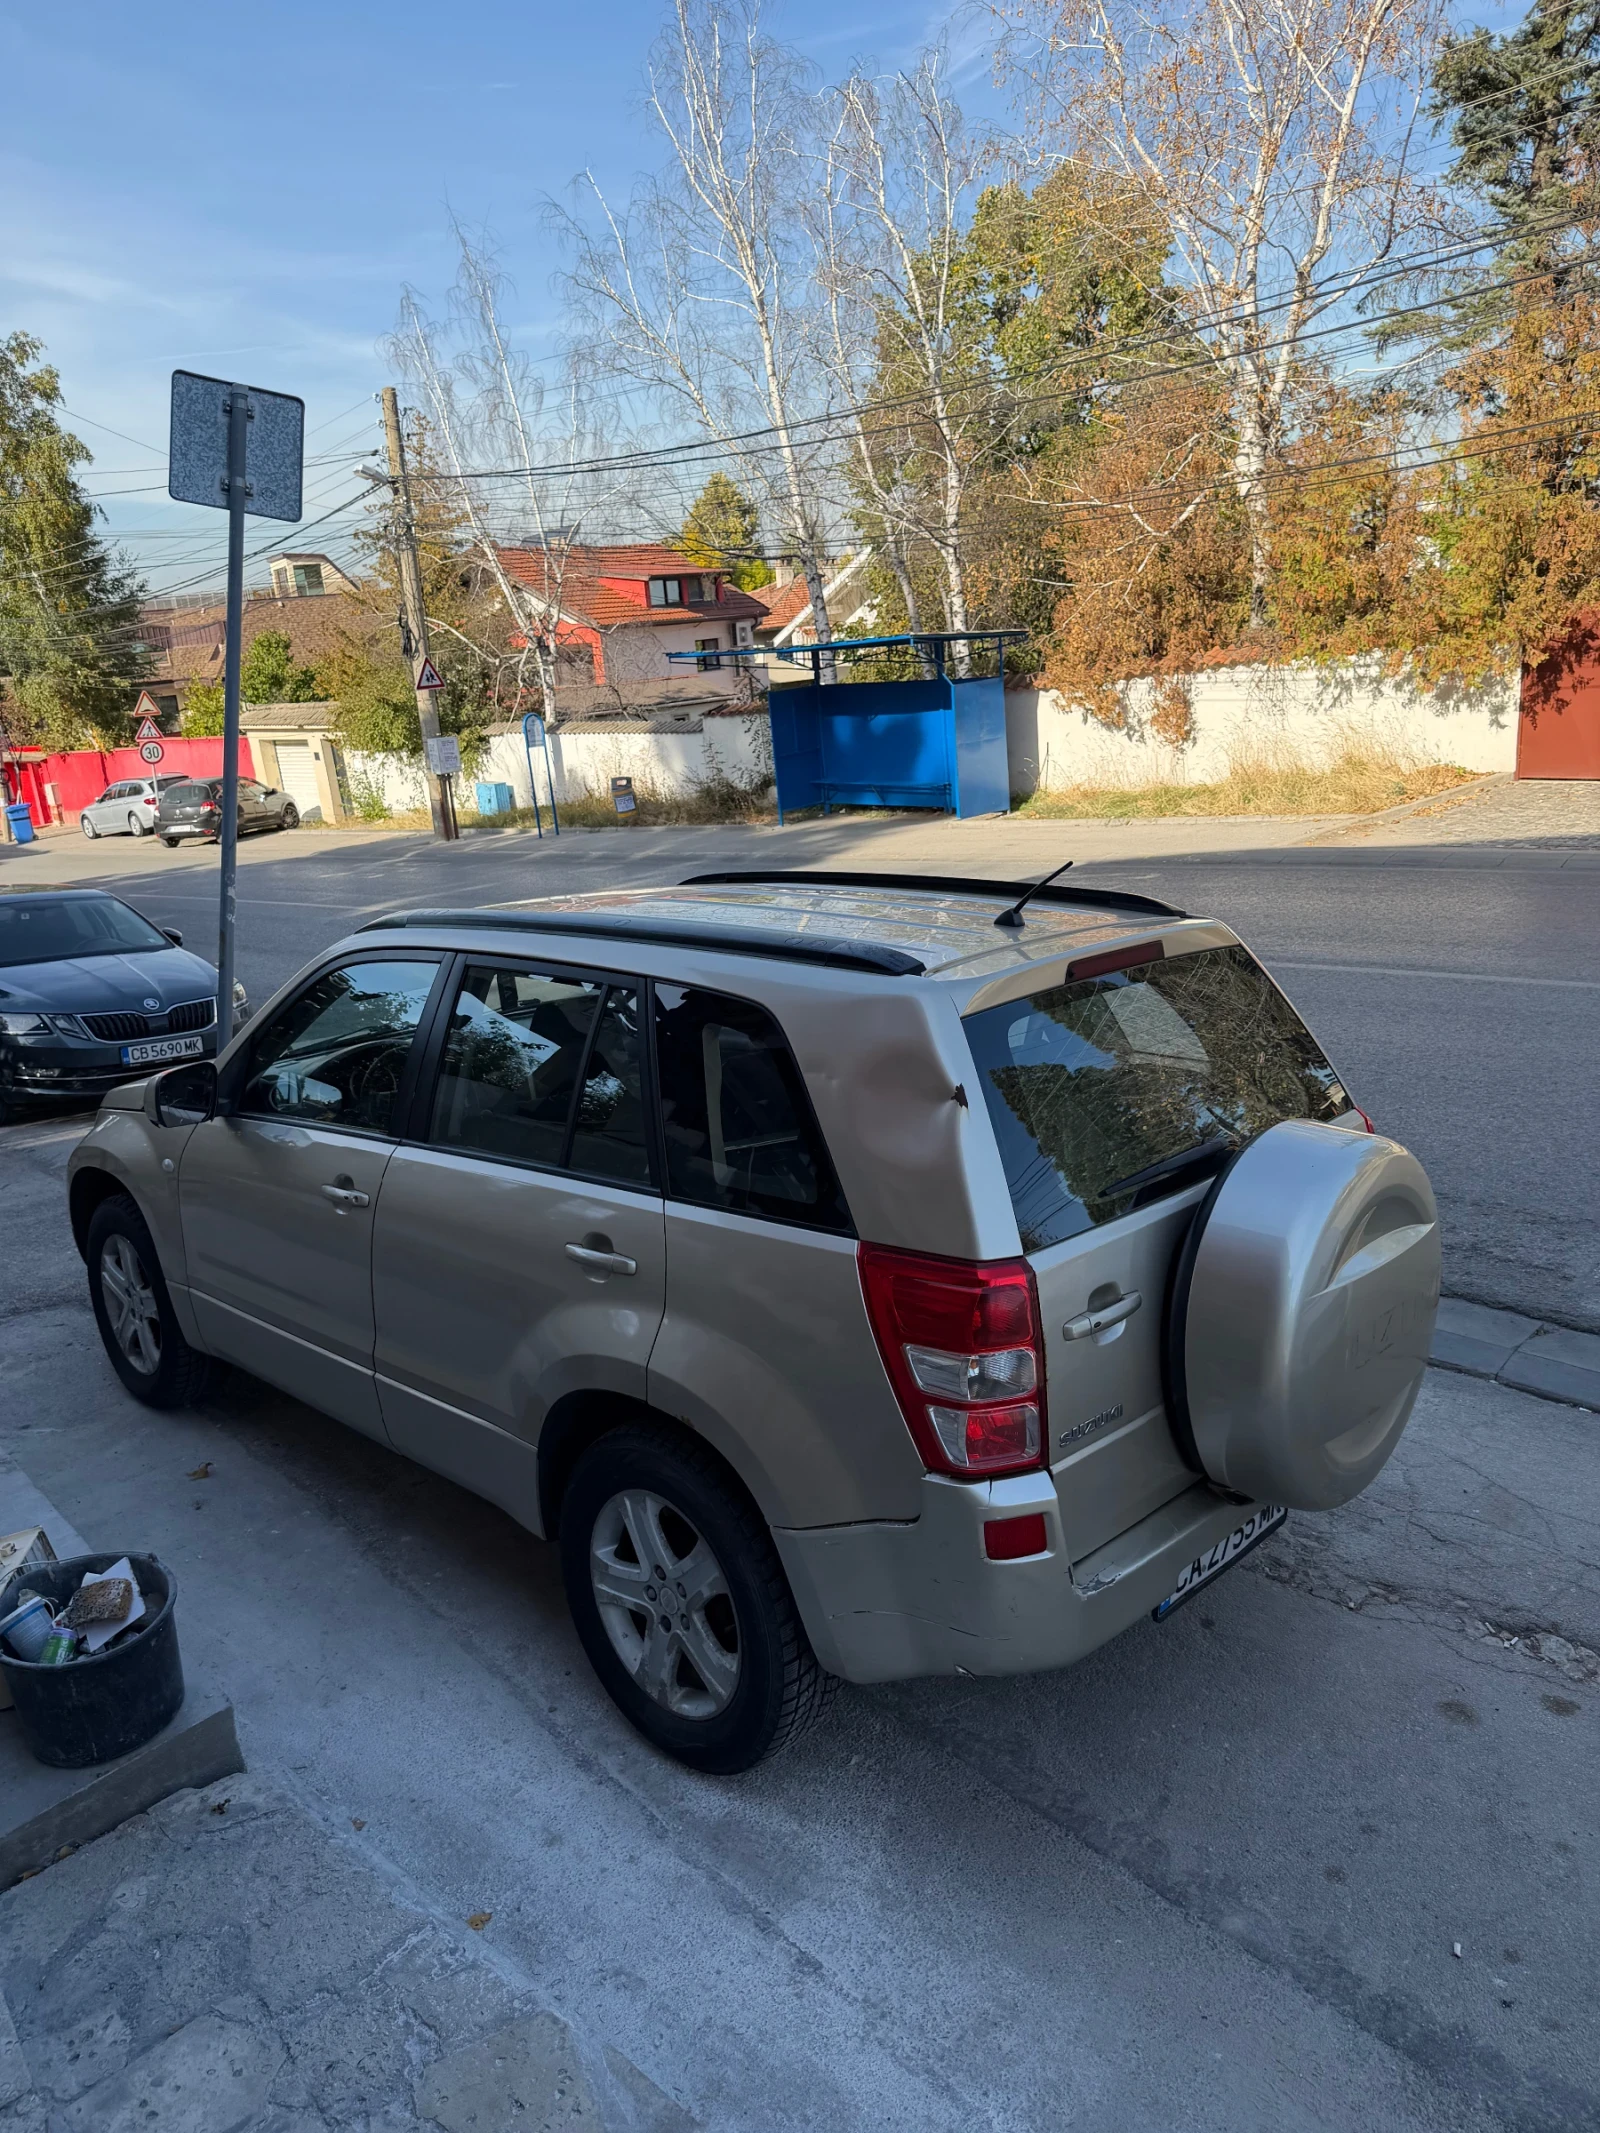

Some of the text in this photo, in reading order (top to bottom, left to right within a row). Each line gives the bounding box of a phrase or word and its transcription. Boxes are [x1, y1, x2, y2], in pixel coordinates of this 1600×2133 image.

[144, 746, 160, 760] 30
[131, 1039, 201, 1061] CB 5690 MK
[1059, 1403, 1123, 1448] SUZUKI
